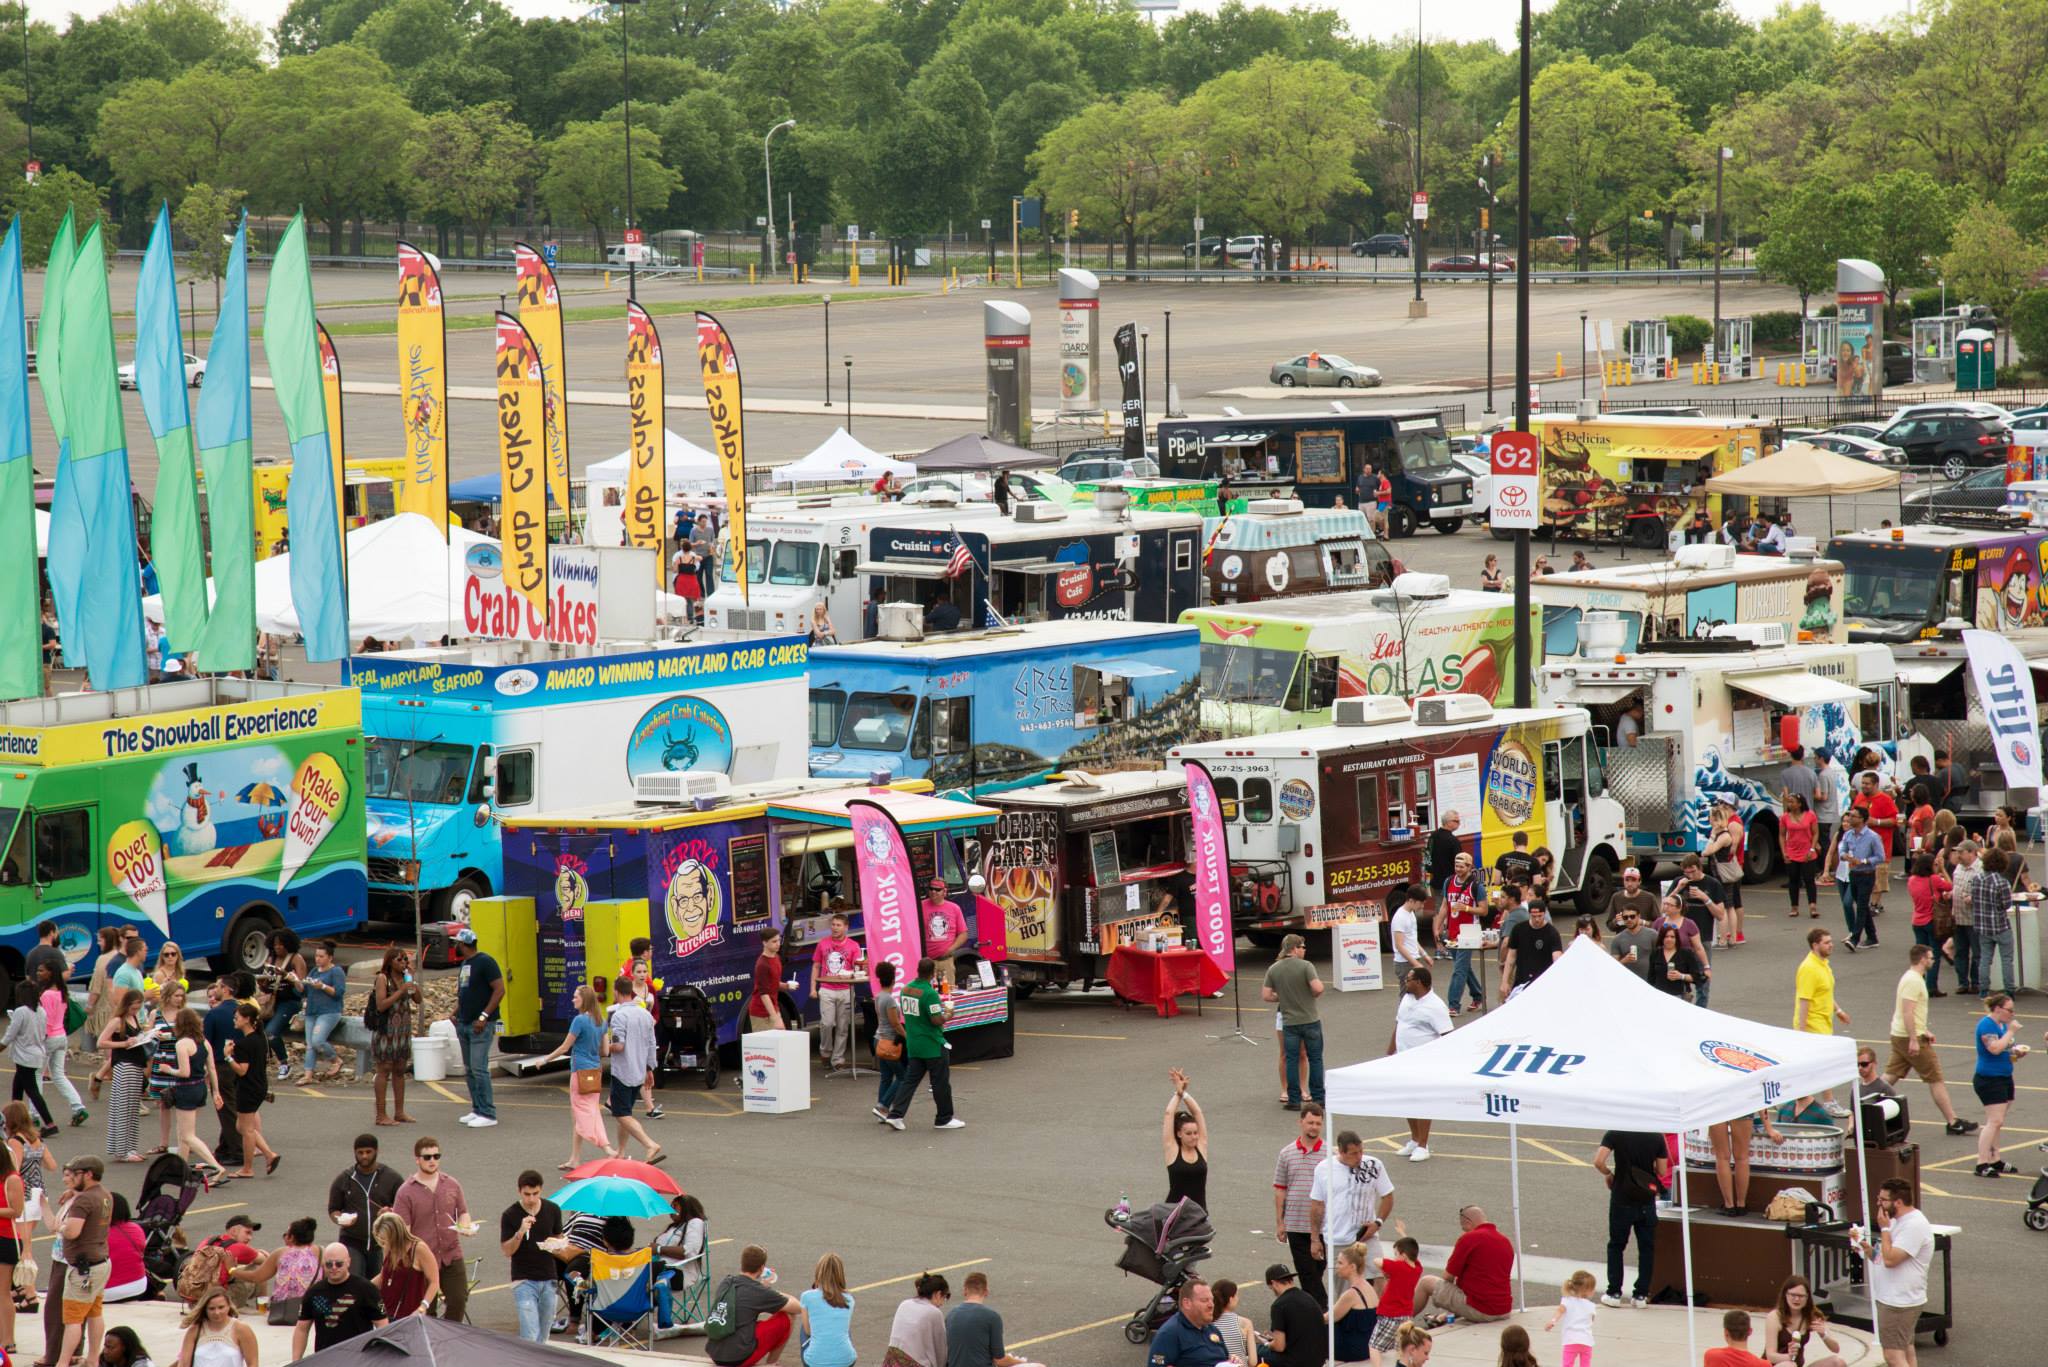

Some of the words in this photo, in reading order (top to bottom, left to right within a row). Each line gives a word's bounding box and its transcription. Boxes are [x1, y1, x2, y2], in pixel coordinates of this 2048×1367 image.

[545, 246, 558, 255] 76
[626, 233, 640, 242] B1
[1168, 437, 1185, 457] PB
[1197, 436, 1206, 457] U
[1566, 431, 1611, 445] Delicias
[1495, 443, 1532, 469] G2
[1494, 508, 1532, 518] TOYOTA
[891, 539, 931, 553] Cruisin'
[552, 555, 598, 588] Winning
[1059, 569, 1090, 588] Cruisin'
[464, 575, 520, 639] Crab
[1743, 583, 1792, 619] CURBSIDE
[1418, 626, 1450, 636] HEALTHY
[1452, 621, 1493, 633] AUTHENTIC
[1497, 619, 1515, 628] MEXI
[1369, 632, 1403, 661] Las
[352, 670, 379, 688] REAL
[380, 663, 442, 691] MARYLAND
[432, 670, 484, 695] SEAFOOD
[545, 667, 596, 692] AWARD
[598, 660, 654, 686] WINNING
[657, 653, 728, 679] MARYLAND
[731, 648, 765, 671] CRAB
[769, 643, 808, 667] CAKES
[1014, 664, 1070, 698] GREE
[1367, 654, 1464, 697] OLAS
[671, 704, 692, 721] Crab
[1032, 695, 1073, 720] STREE
[103, 729, 139, 757] The
[141, 714, 220, 753] Snowball
[225, 707, 319, 741] Experience
[1342, 757, 1387, 773] RESTAURANT
[1387, 757, 1398, 767] ON
[1398, 754, 1426, 766] WHEELS
[1491, 749, 1537, 779] WORLD'S
[302, 764, 341, 809] Make
[1489, 769, 1536, 801] BEST
[299, 787, 329, 826] Your
[1280, 792, 1313, 808] BEST
[1488, 792, 1511, 812] CRAB
[1511, 799, 1533, 819] CAKE
[290, 813, 322, 846] Own!
[998, 812, 1058, 841] OEBE'S
[113, 832, 149, 871] Over
[124, 853, 156, 891] 100
[1329, 860, 1411, 887] 267-255-3963
[1331, 876, 1410, 896] WorldsBestCrabCake.com
[1011, 903, 1037, 918] Marks
[1020, 914, 1036, 925] The
[1311, 906, 1347, 923] PHOEBE'S
[678, 926, 717, 955] KITCHEN
[1019, 920, 1047, 941] HOT
[1472, 1043, 1587, 1078] Lite
[1484, 1092, 1520, 1117] Lite
[1763, 1080, 1781, 1105] Lite
